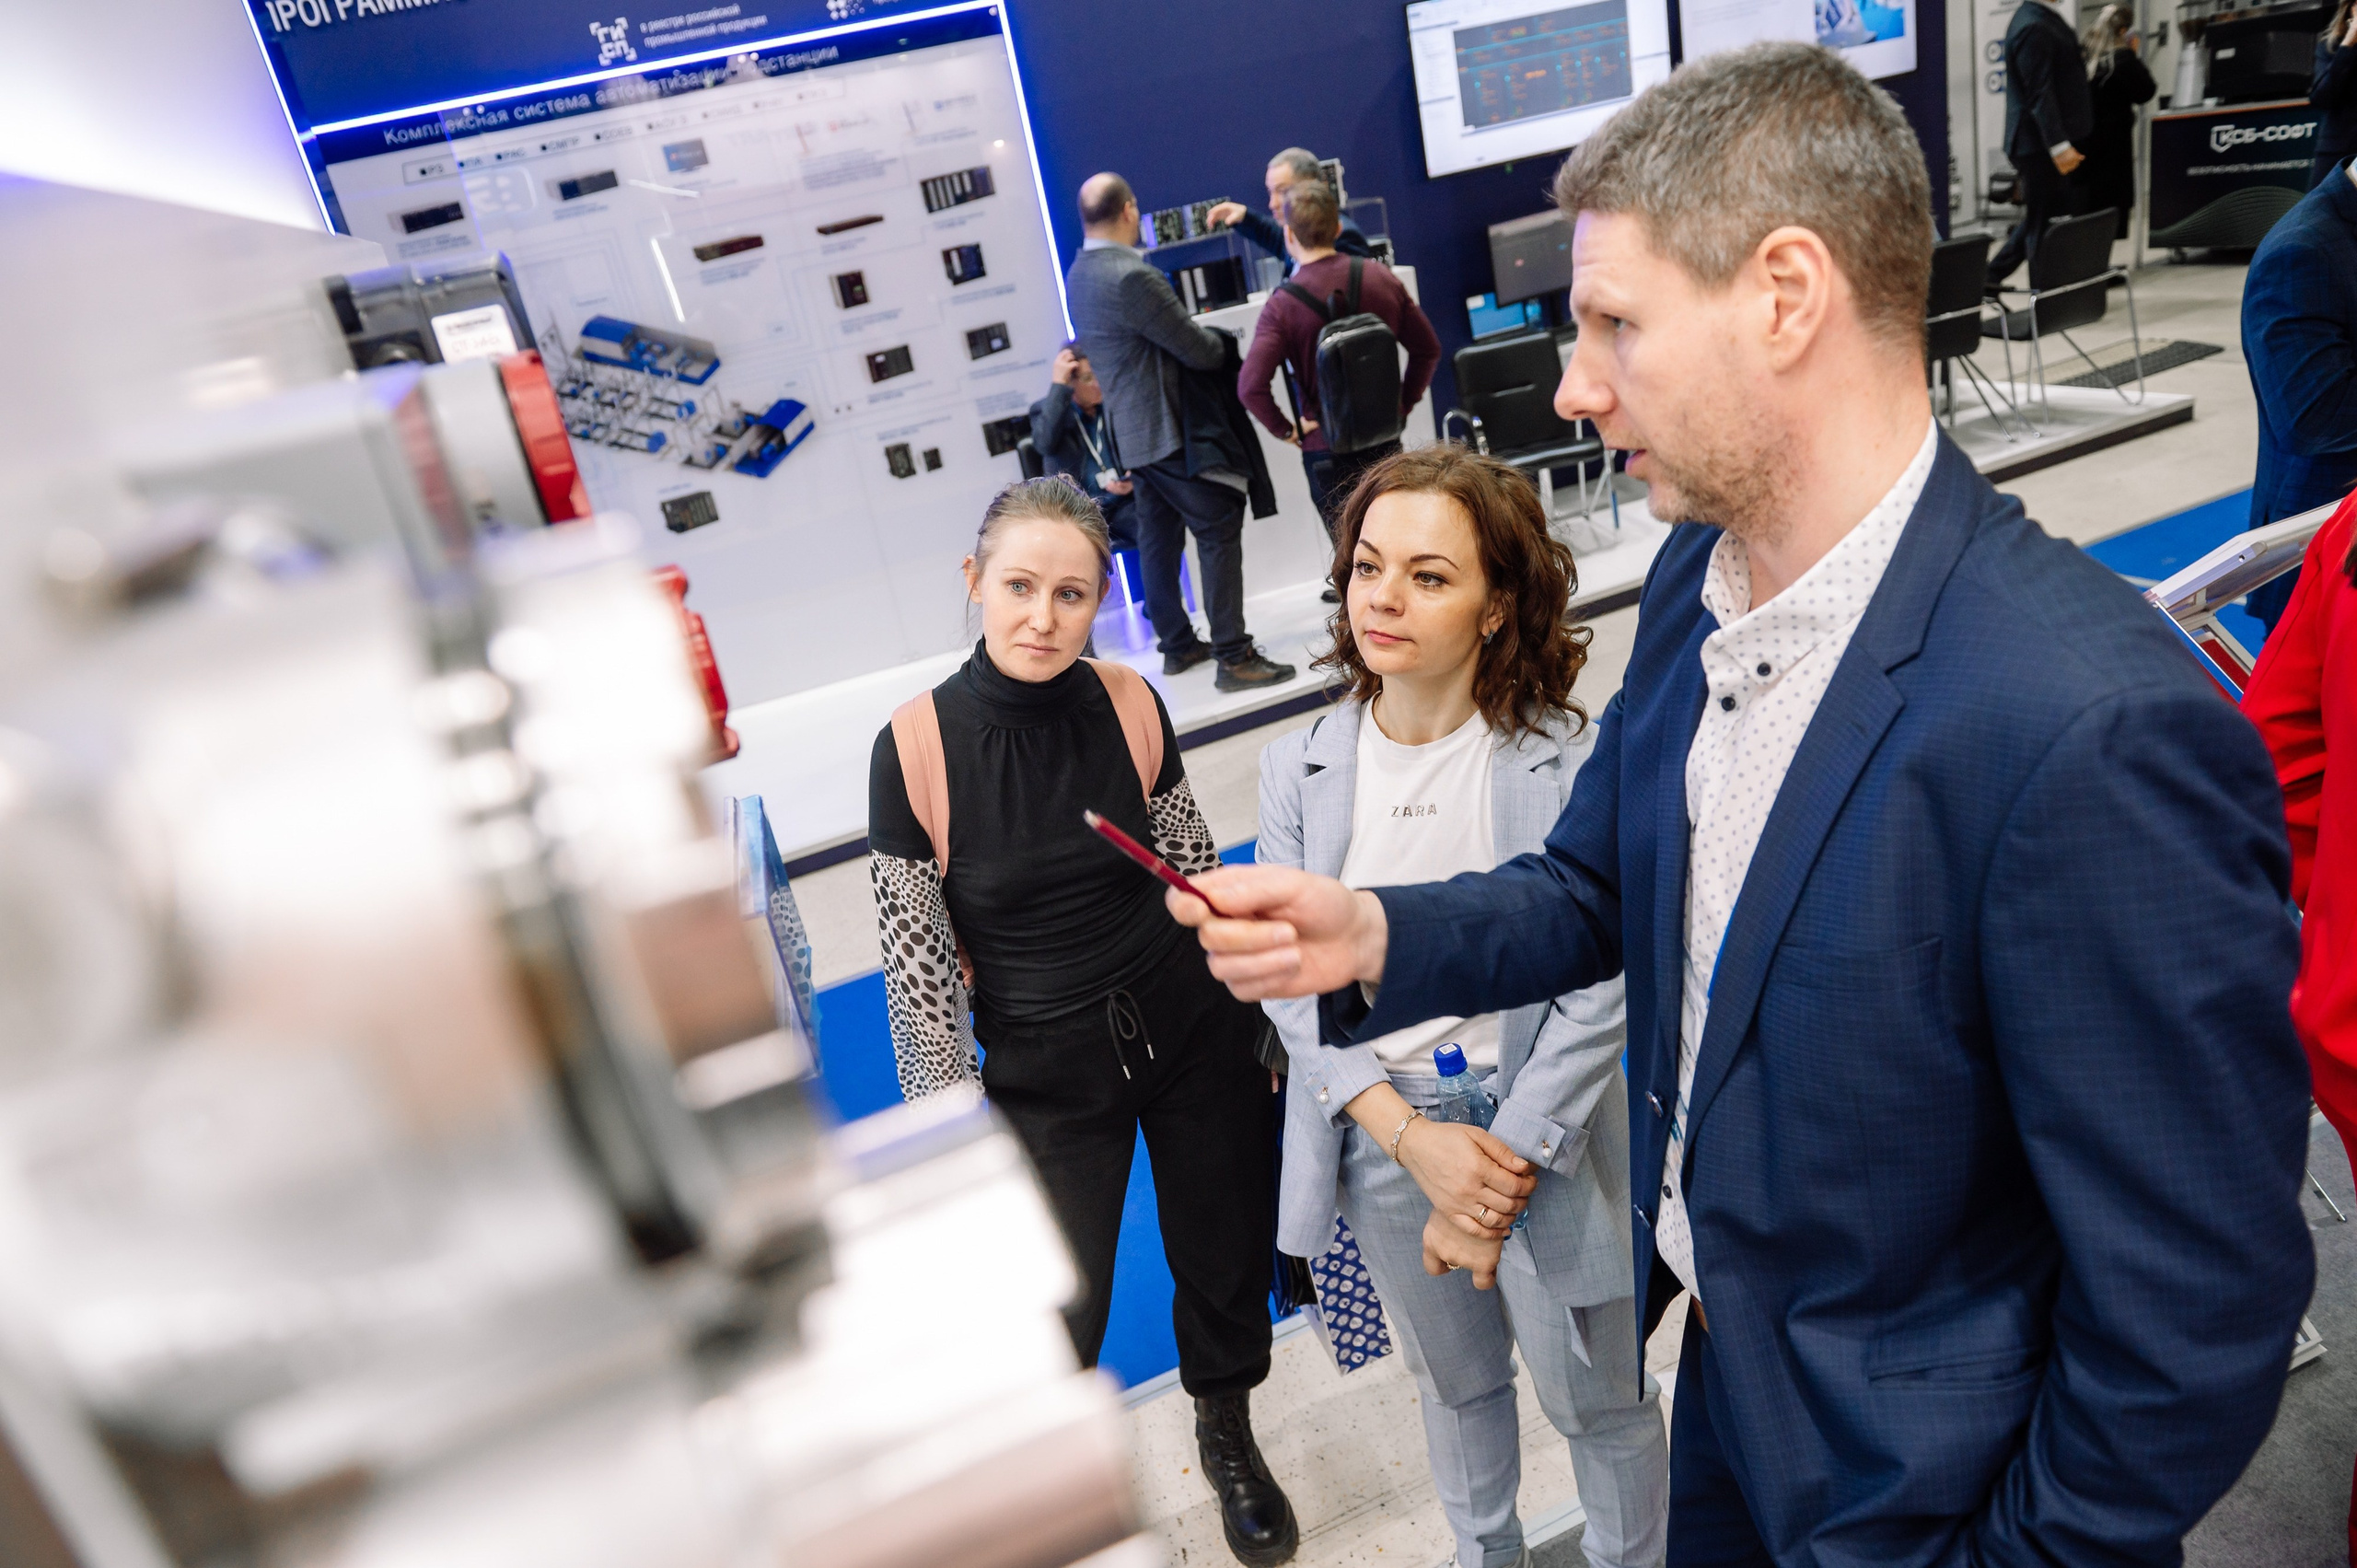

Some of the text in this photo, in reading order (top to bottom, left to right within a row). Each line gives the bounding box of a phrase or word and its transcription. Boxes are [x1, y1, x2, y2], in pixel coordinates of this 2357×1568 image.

[640, 3, 741, 33] в реестре российской
[644, 15, 769, 49] промышленной продукции
[383, 109, 509, 145] Комплексная
[513, 93, 591, 121] система
[595, 66, 729, 105] автоматизации
[2217, 122, 2318, 147] КСБ-СОФТ
[1390, 803, 1437, 818] ZARA
